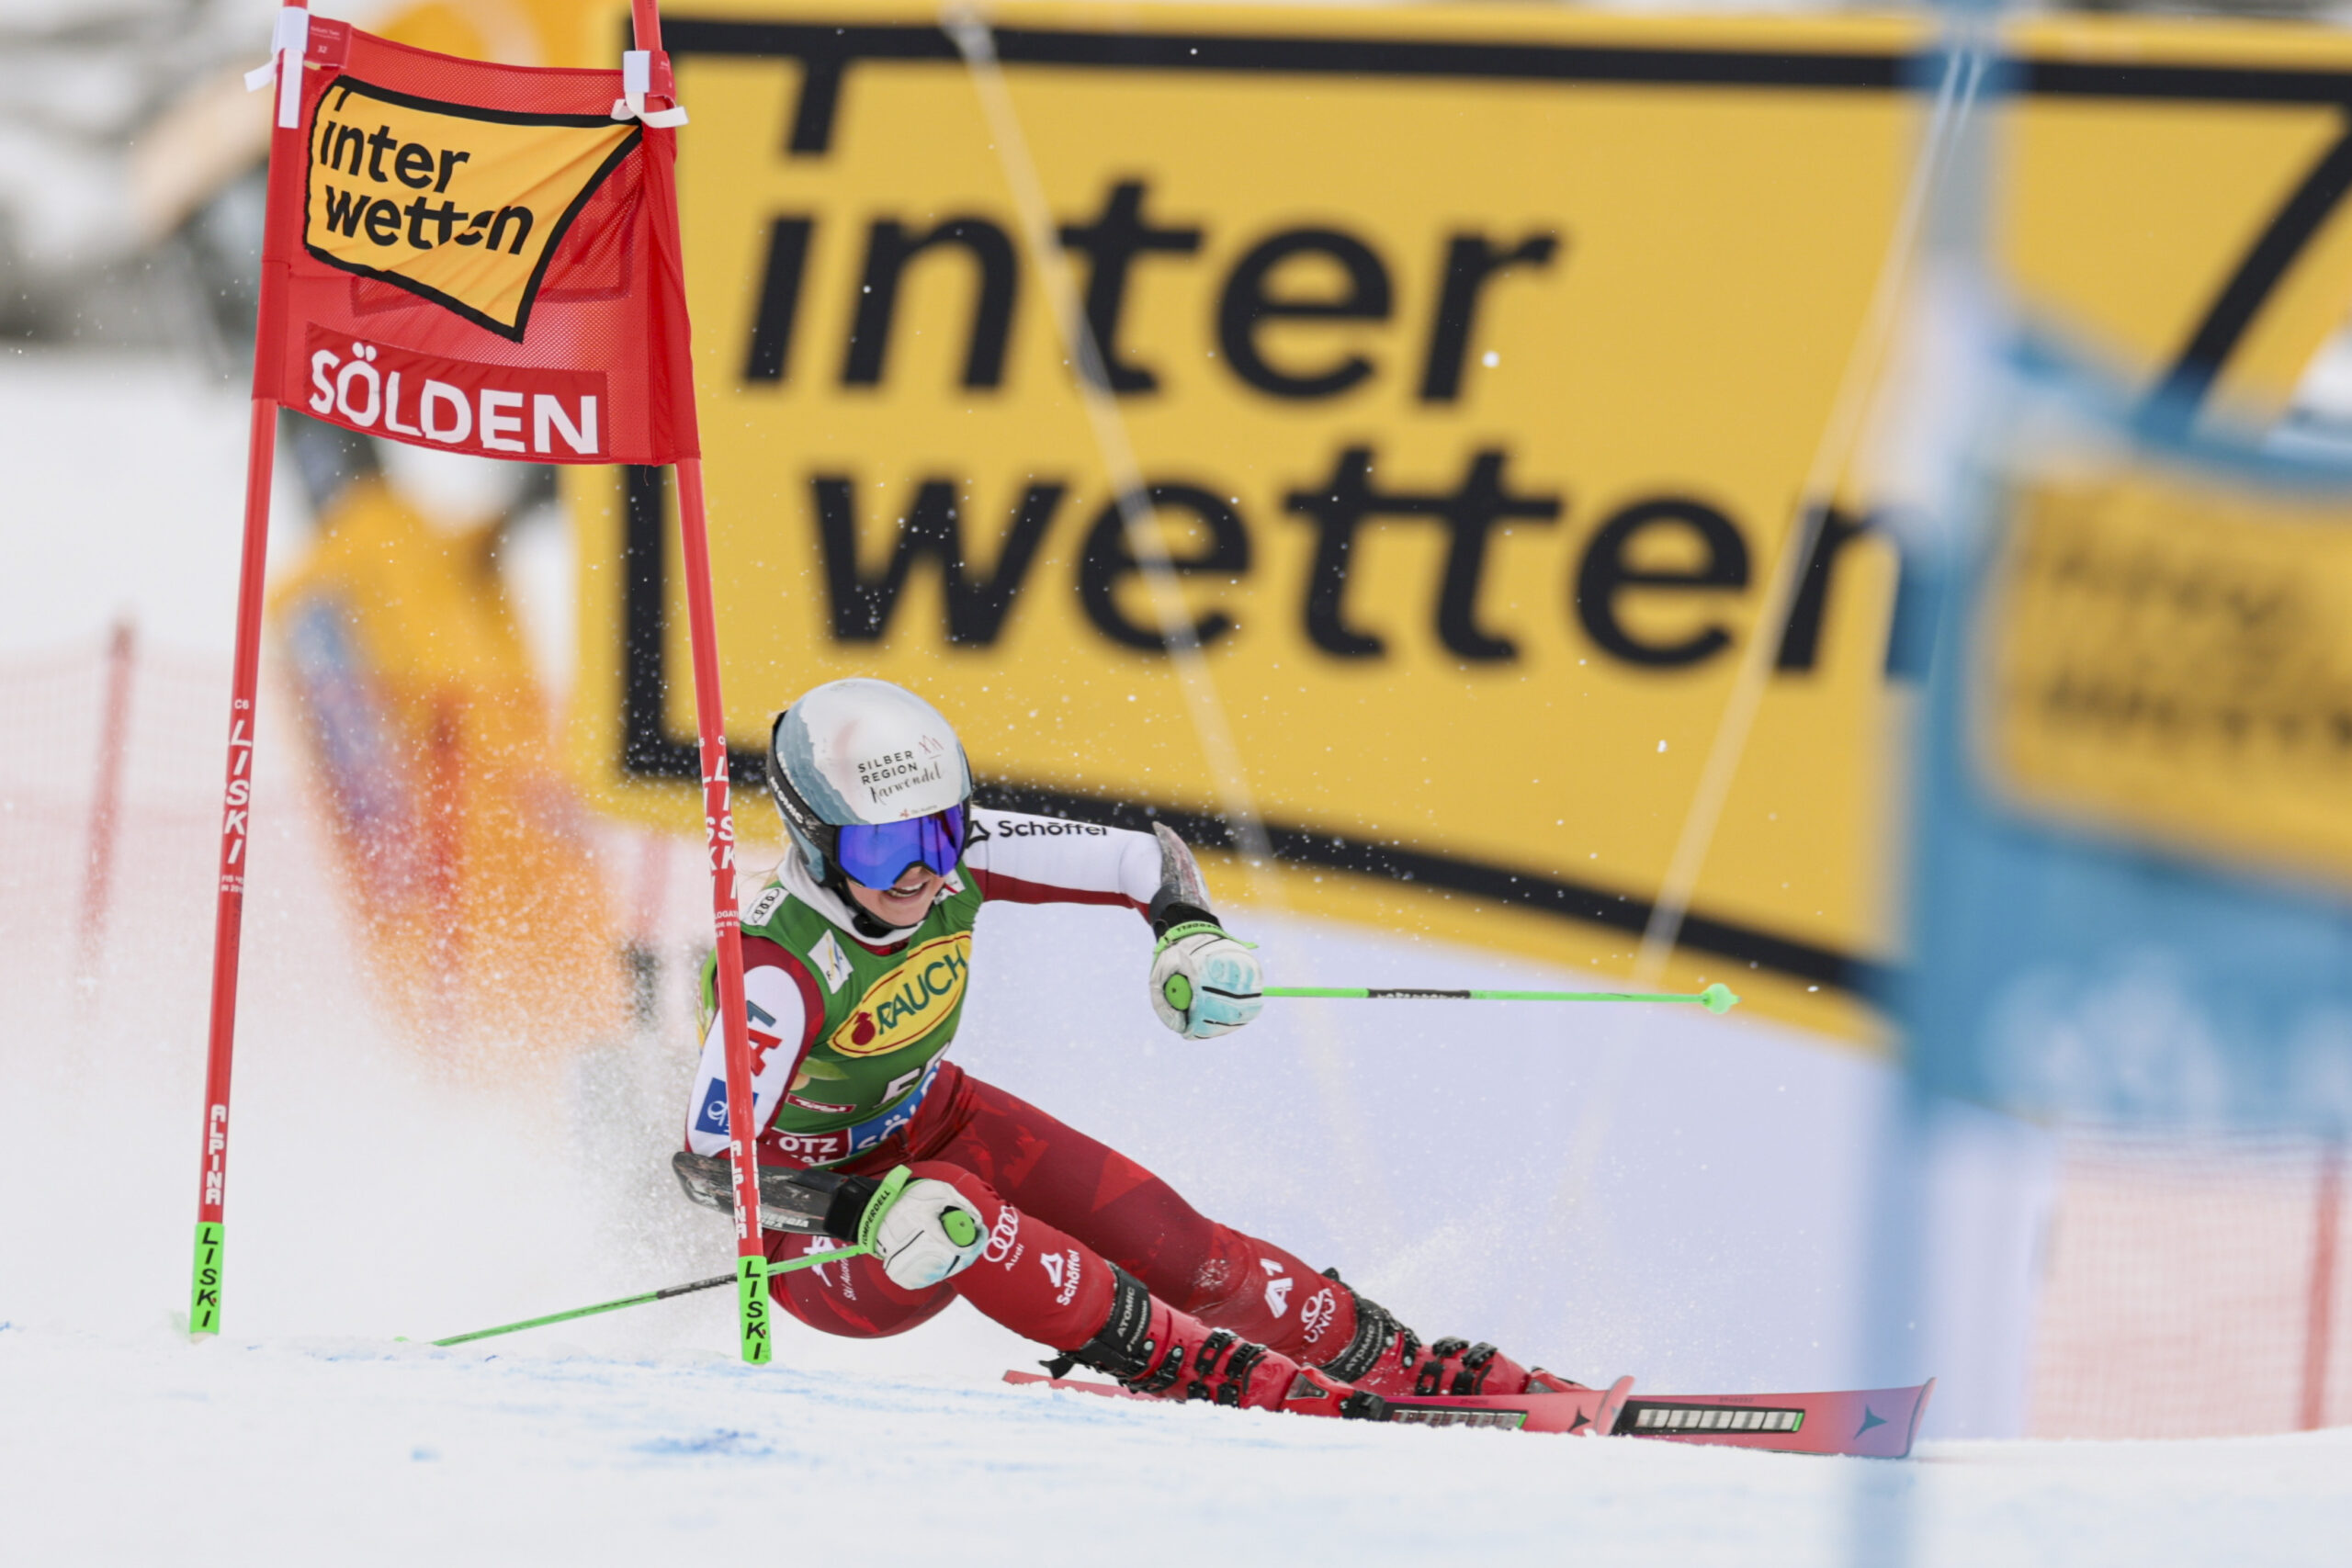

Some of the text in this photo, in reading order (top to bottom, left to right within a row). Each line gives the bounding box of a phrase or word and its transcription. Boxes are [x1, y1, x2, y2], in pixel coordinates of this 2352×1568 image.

[320, 121, 470, 193] inter
[325, 185, 534, 255] wetten
[742, 176, 1562, 406] inter
[310, 342, 599, 455] SÖLDEN
[802, 444, 1940, 680] wetten
[224, 719, 253, 864] LISKI
[857, 750, 913, 773] SILBER
[861, 762, 918, 784] REGION
[876, 943, 968, 1035] RAUCH
[204, 1104, 226, 1206] ALPINA
[197, 1227, 218, 1327] LISKI
[1004, 1243, 1024, 1271] Audi
[1057, 1249, 1080, 1306] Schöffel
[1260, 1258, 1294, 1319] A1
[745, 1261, 766, 1360] LISKI
[1116, 1287, 1136, 1338] ATOMIC
